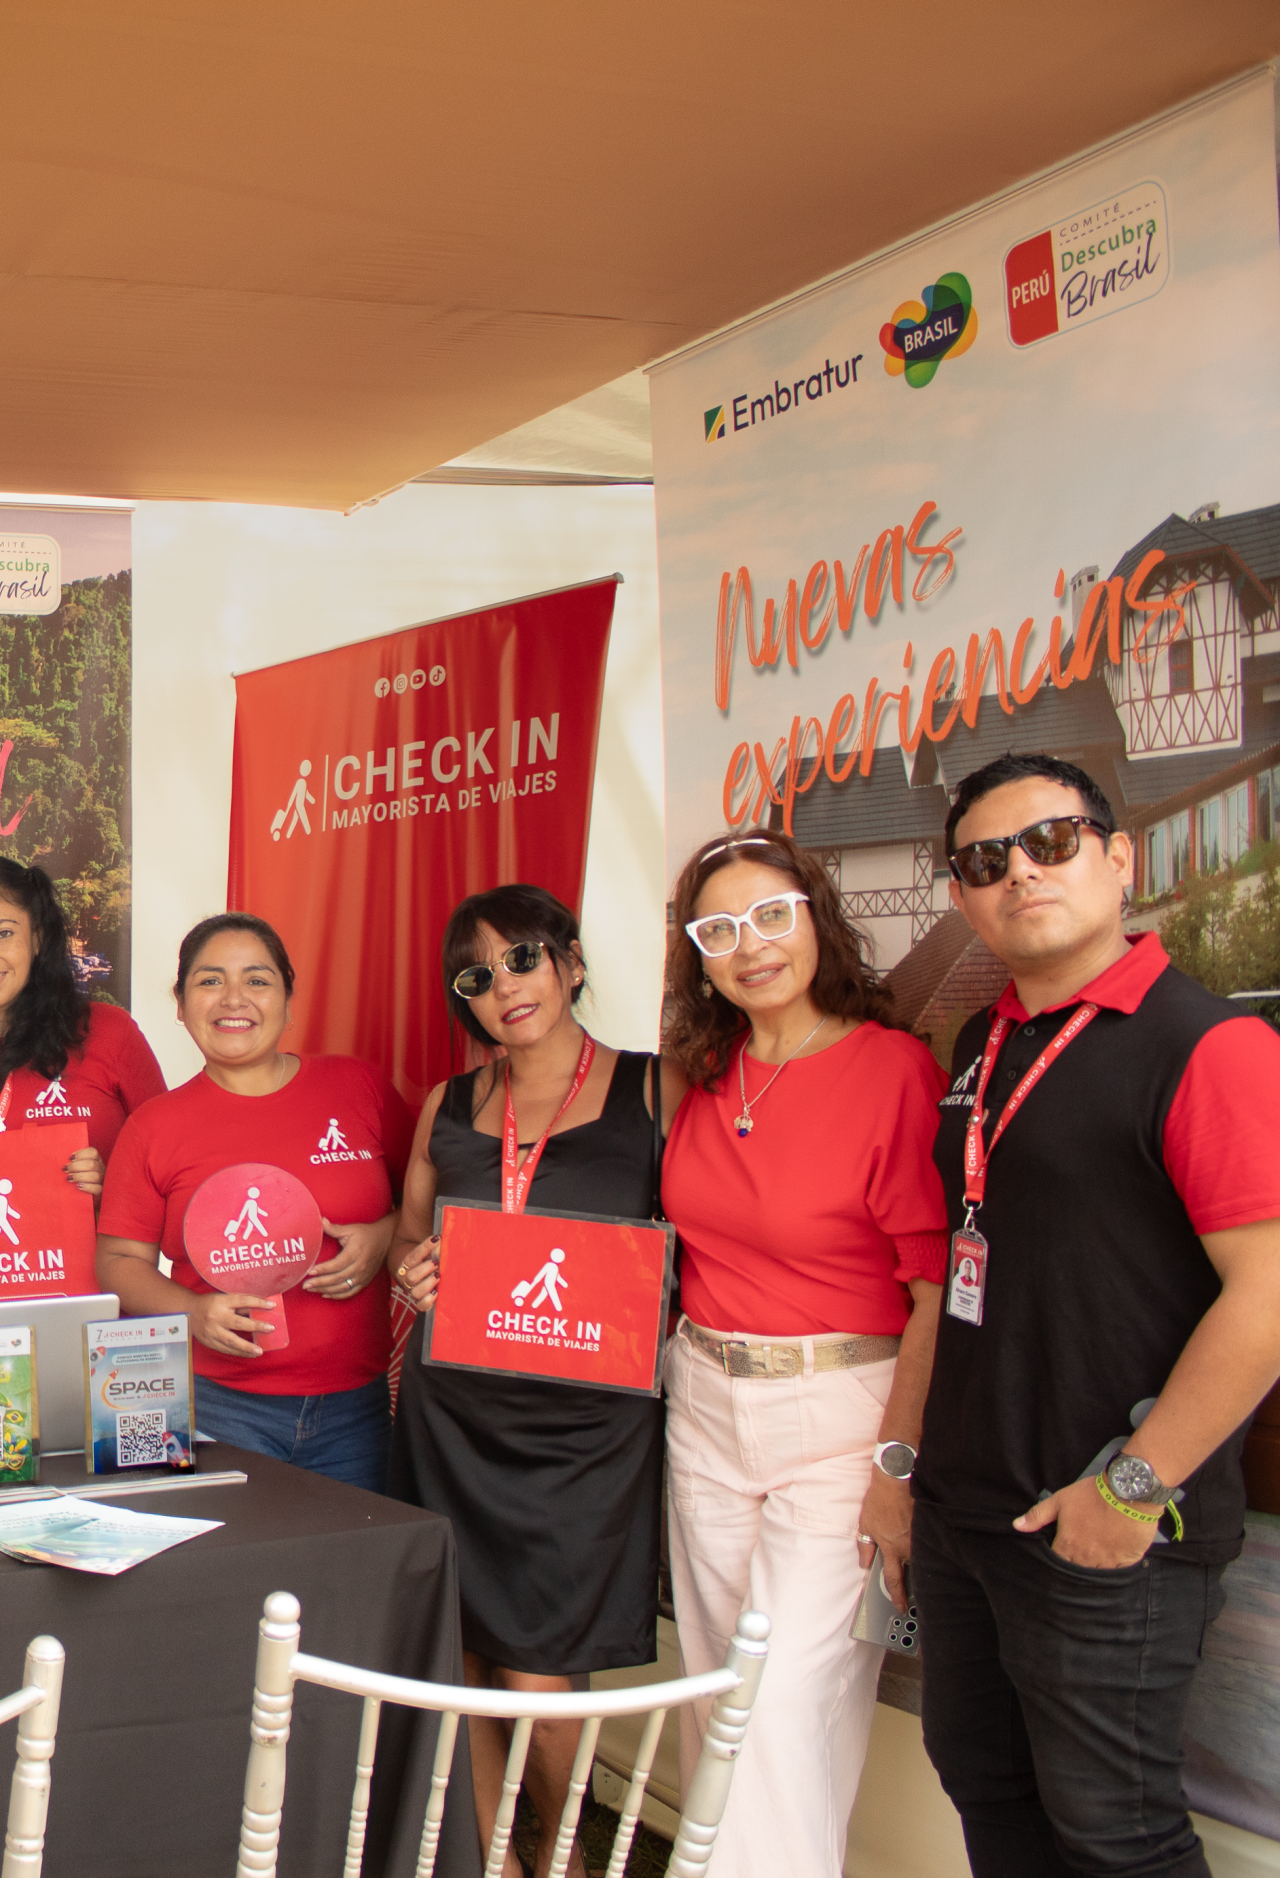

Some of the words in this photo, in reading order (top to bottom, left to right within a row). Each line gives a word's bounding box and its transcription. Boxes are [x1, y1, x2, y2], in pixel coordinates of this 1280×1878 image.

[1059, 202, 1120, 238] COMITÉ
[1061, 218, 1157, 272] Descubra
[1060, 232, 1161, 319] Brasil
[1011, 270, 1050, 309] PERÚ
[904, 314, 959, 354] BRASIL
[733, 353, 863, 432] Embratur
[715, 501, 963, 710] Nuevas
[722, 549, 1197, 837] experiencias
[333, 726, 496, 801] CHECK
[511, 712, 560, 768] IN
[332, 791, 451, 830] MAYORISTA
[458, 786, 482, 811] DE
[488, 770, 557, 801] VIAJES
[1063, 1010, 1090, 1037] CHECK
[1054, 1038, 1065, 1049] IN
[583, 1046, 592, 1068] CHECK
[982, 1055, 991, 1066] IN
[1017, 1069, 1039, 1098] CHECK
[963, 1094, 975, 1106] IN
[1008, 1098, 1020, 1110] IN
[25, 1106, 73, 1119] CHECK
[77, 1106, 91, 1117] IN
[508, 1127, 514, 1136] IN
[310, 1150, 358, 1165] CHECK
[358, 1149, 372, 1160] IN
[507, 1137, 515, 1157] CHECK
[968, 1134, 977, 1167] CHECK
[527, 1155, 534, 1164] IN
[507, 1177, 514, 1186] IN
[38, 1248, 64, 1270] IN
[209, 1241, 278, 1265] CHECK
[283, 1237, 305, 1254] IN
[963, 1244, 977, 1254] CHECK
[211, 1261, 261, 1274] MAYORISTA
[263, 1258, 274, 1266] DE
[275, 1253, 307, 1264] VIAJES
[11, 1273, 26, 1284] DE
[27, 1271, 65, 1283] VIAJES
[110, 1330, 134, 1338] CHECK
[487, 1310, 568, 1339] CHECK
[578, 1320, 602, 1342] IN
[486, 1329, 545, 1345] MAYORISTA
[546, 1337, 560, 1347] DE
[563, 1339, 600, 1351] VIAJES
[109, 1377, 175, 1396] SPACE
[146, 1391, 167, 1399] CHECK
